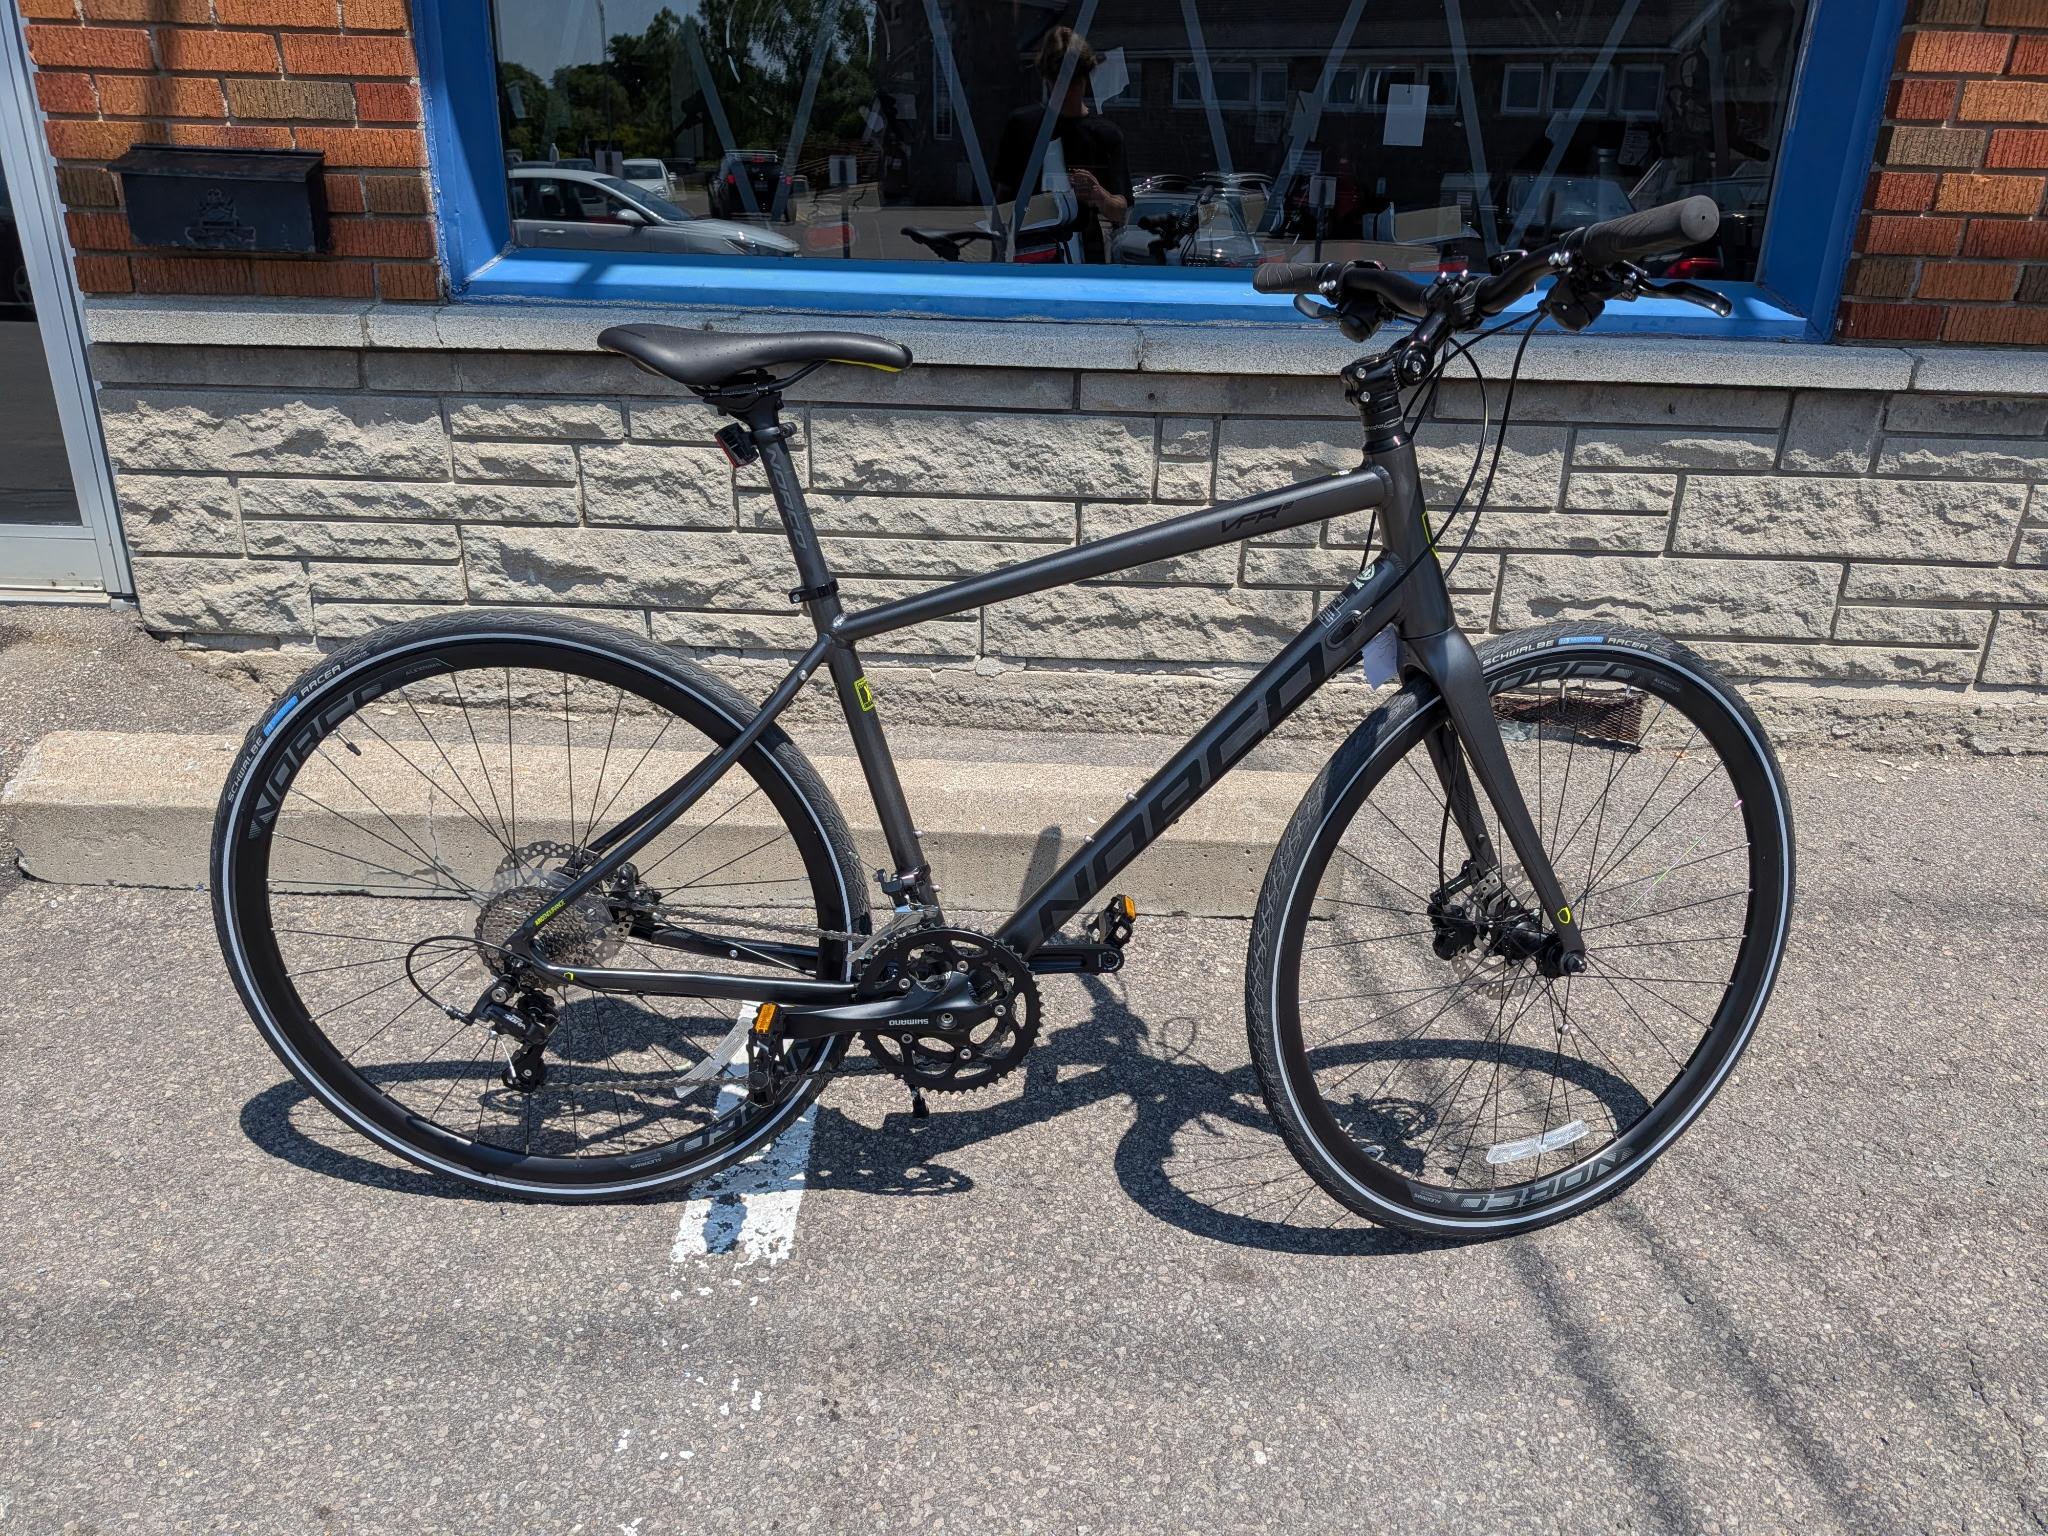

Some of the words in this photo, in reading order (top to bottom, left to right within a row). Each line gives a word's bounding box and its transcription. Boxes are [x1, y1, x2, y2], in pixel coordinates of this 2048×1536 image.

[1482, 639, 1554, 666] SCHWALBE
[1607, 637, 1648, 651] RACER
[1488, 661, 1638, 696] ORCO
[227, 736, 263, 803] SCHWALBE
[301, 665, 341, 697] RACER
[249, 682, 384, 839] NORCO
[1038, 643, 1326, 943] NORCO
[888, 1018, 929, 1027] SHIMANO
[1455, 1148, 1633, 1212] NORCO
